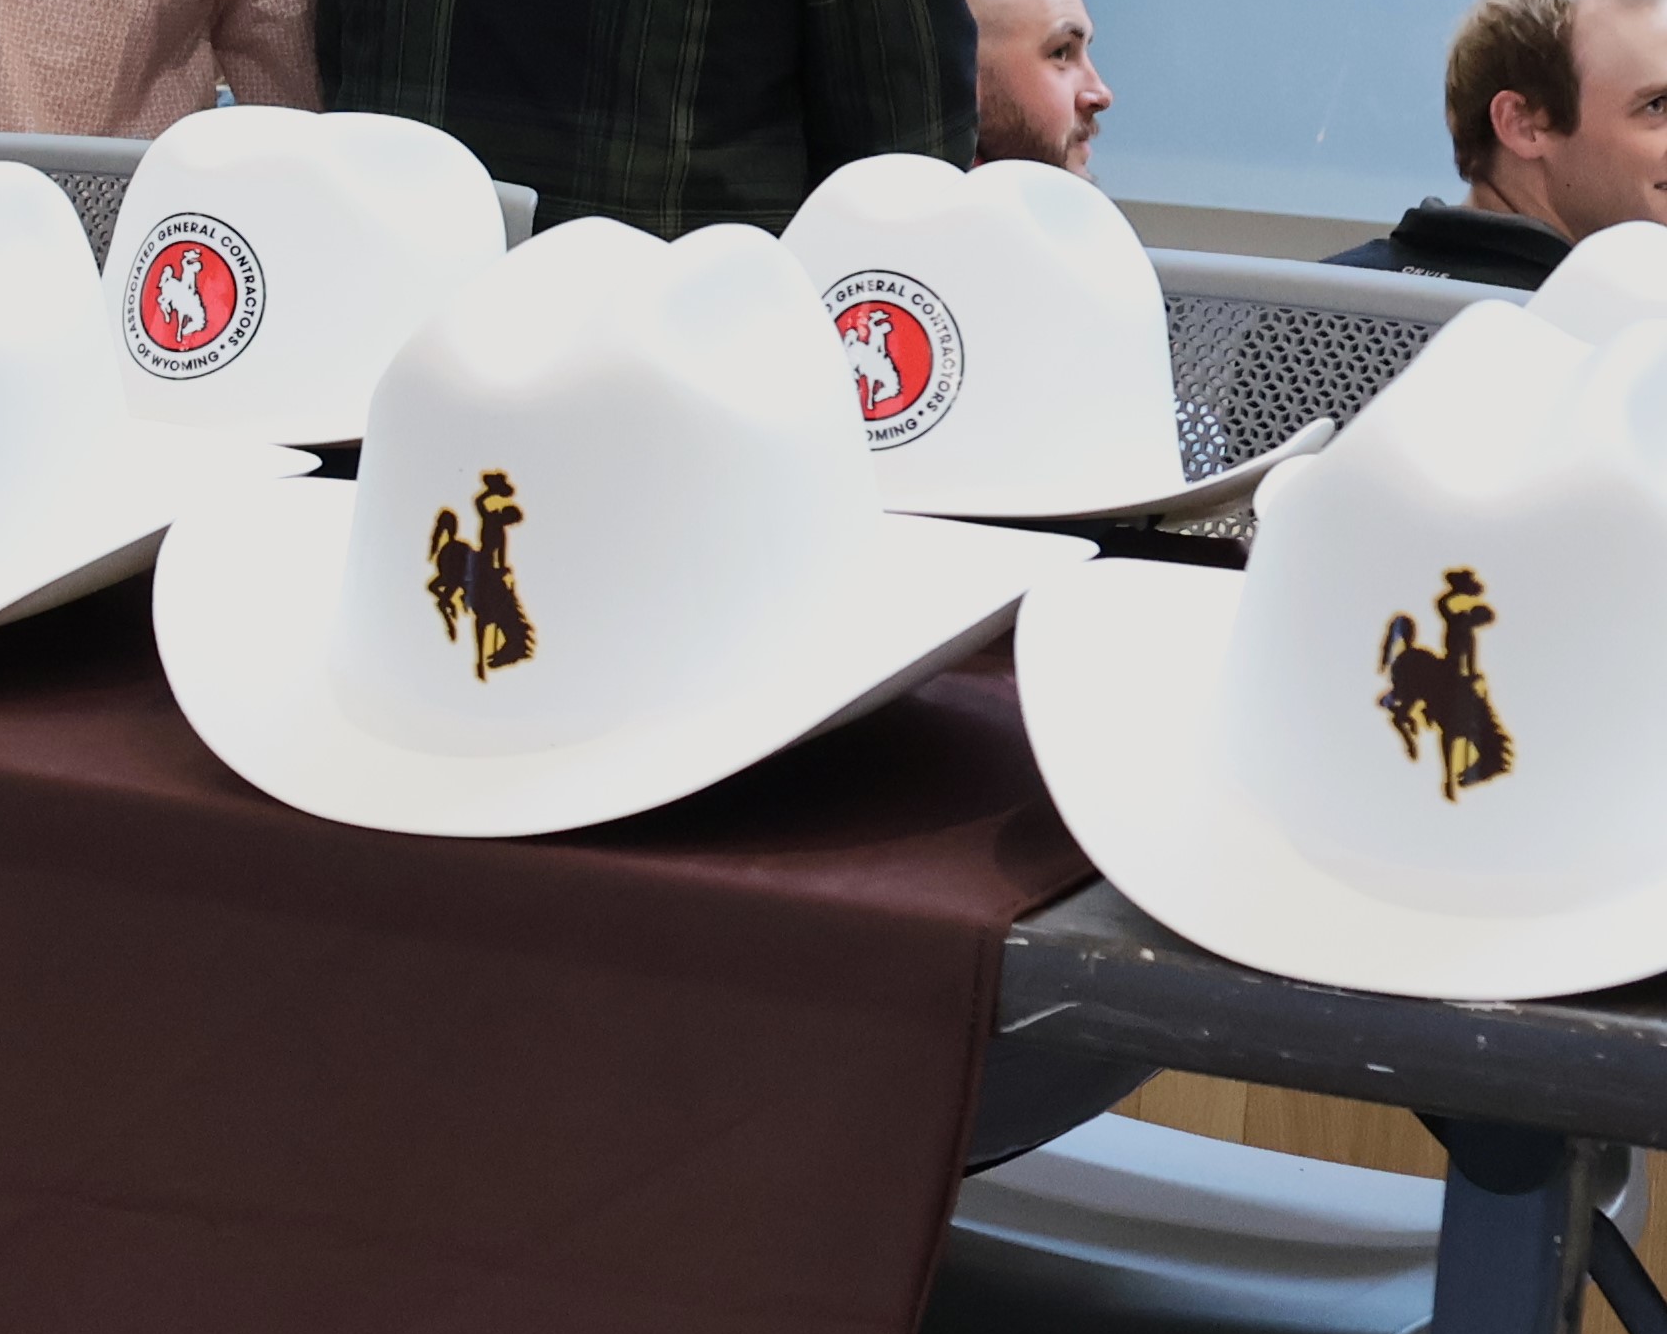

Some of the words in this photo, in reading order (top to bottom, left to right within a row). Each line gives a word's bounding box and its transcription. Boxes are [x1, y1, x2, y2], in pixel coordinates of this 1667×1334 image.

[128, 241, 155, 332] ASSOCIATED
[158, 222, 216, 241] GENERAL
[220, 236, 257, 347] CONTRACTORS
[835, 280, 905, 303] GENERAL
[911, 293, 956, 413] CONTRACTORS
[137, 343, 151, 359] OF
[151, 351, 219, 372] WYOMING
